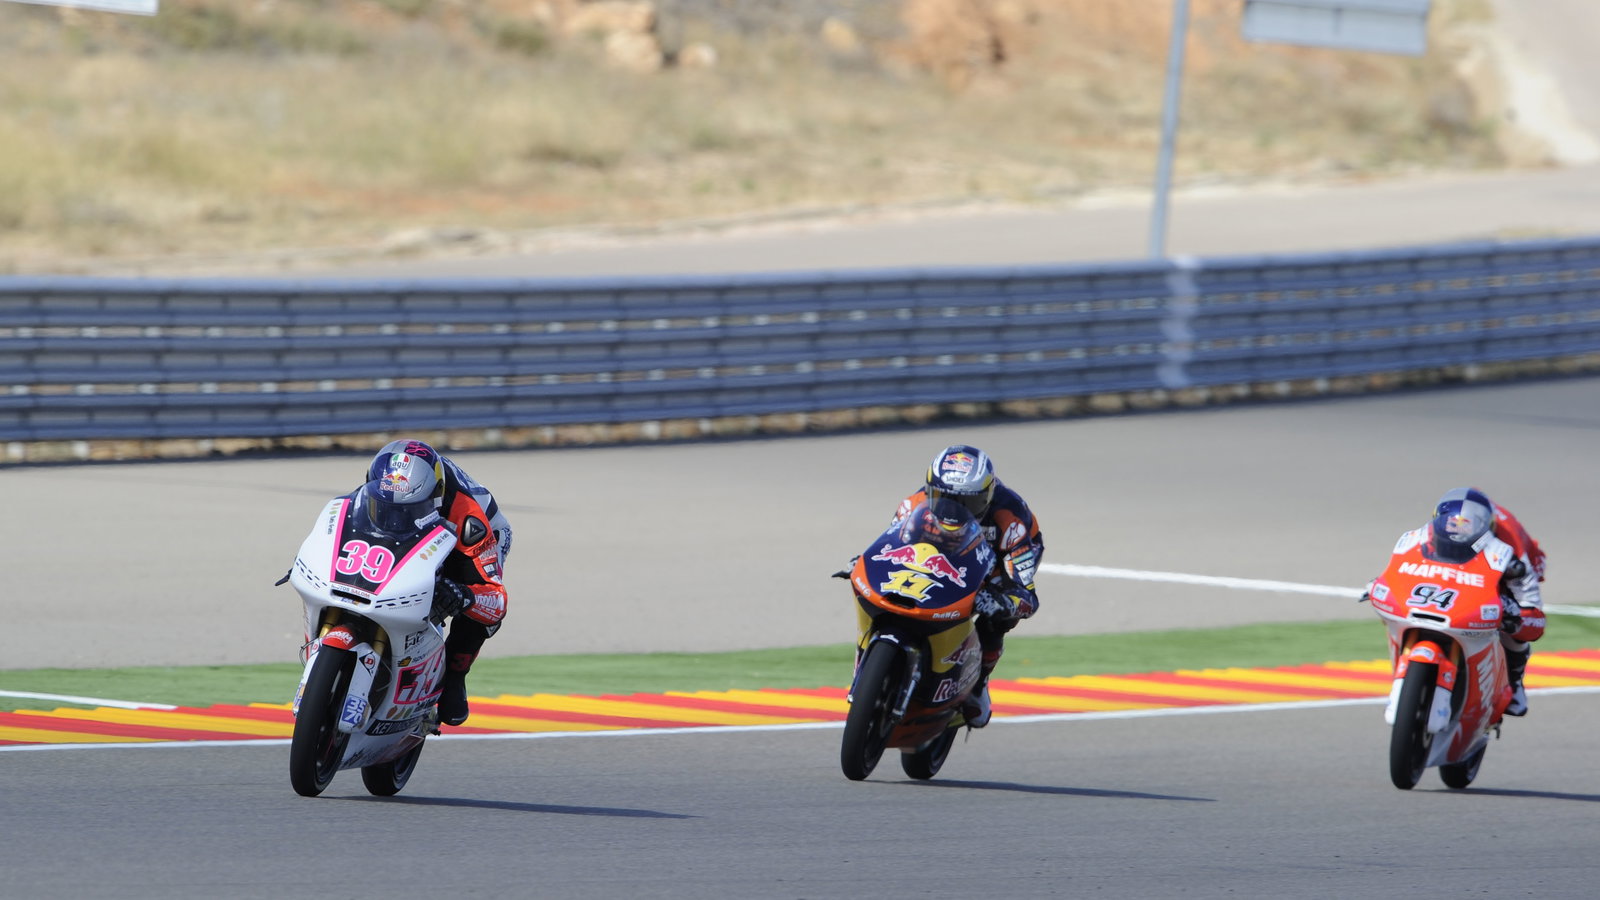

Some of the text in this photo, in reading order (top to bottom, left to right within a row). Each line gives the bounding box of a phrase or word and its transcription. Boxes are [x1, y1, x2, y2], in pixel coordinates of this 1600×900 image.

[336, 540, 396, 583] 39
[1398, 562, 1485, 588] MAPFRE
[880, 570, 938, 603] 11
[1407, 584, 1459, 611] 94
